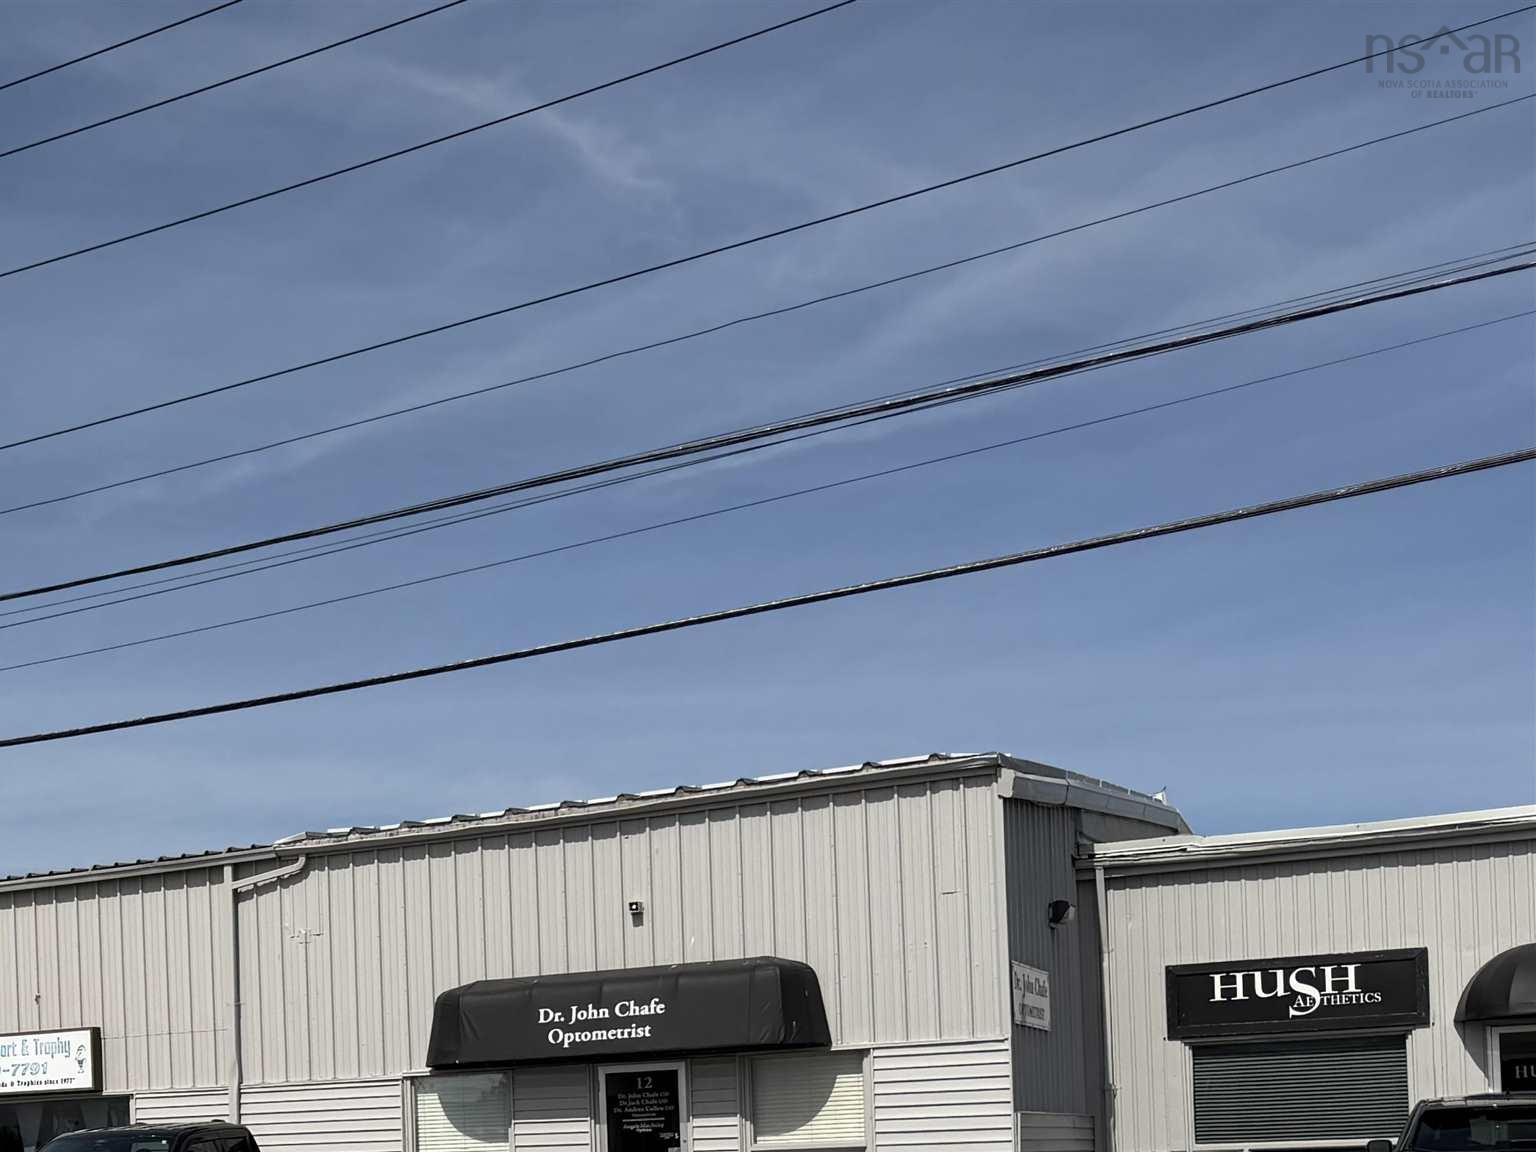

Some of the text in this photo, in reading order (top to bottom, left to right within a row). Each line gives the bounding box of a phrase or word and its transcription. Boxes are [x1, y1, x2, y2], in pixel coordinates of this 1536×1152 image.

[538, 998, 666, 1025] Dr. John Chafe
[547, 1023, 652, 1048] Optometrist
[21, 1039, 30, 1056] &
[33, 1037, 71, 1059] Trophy
[637, 1076, 653, 1089] 12
